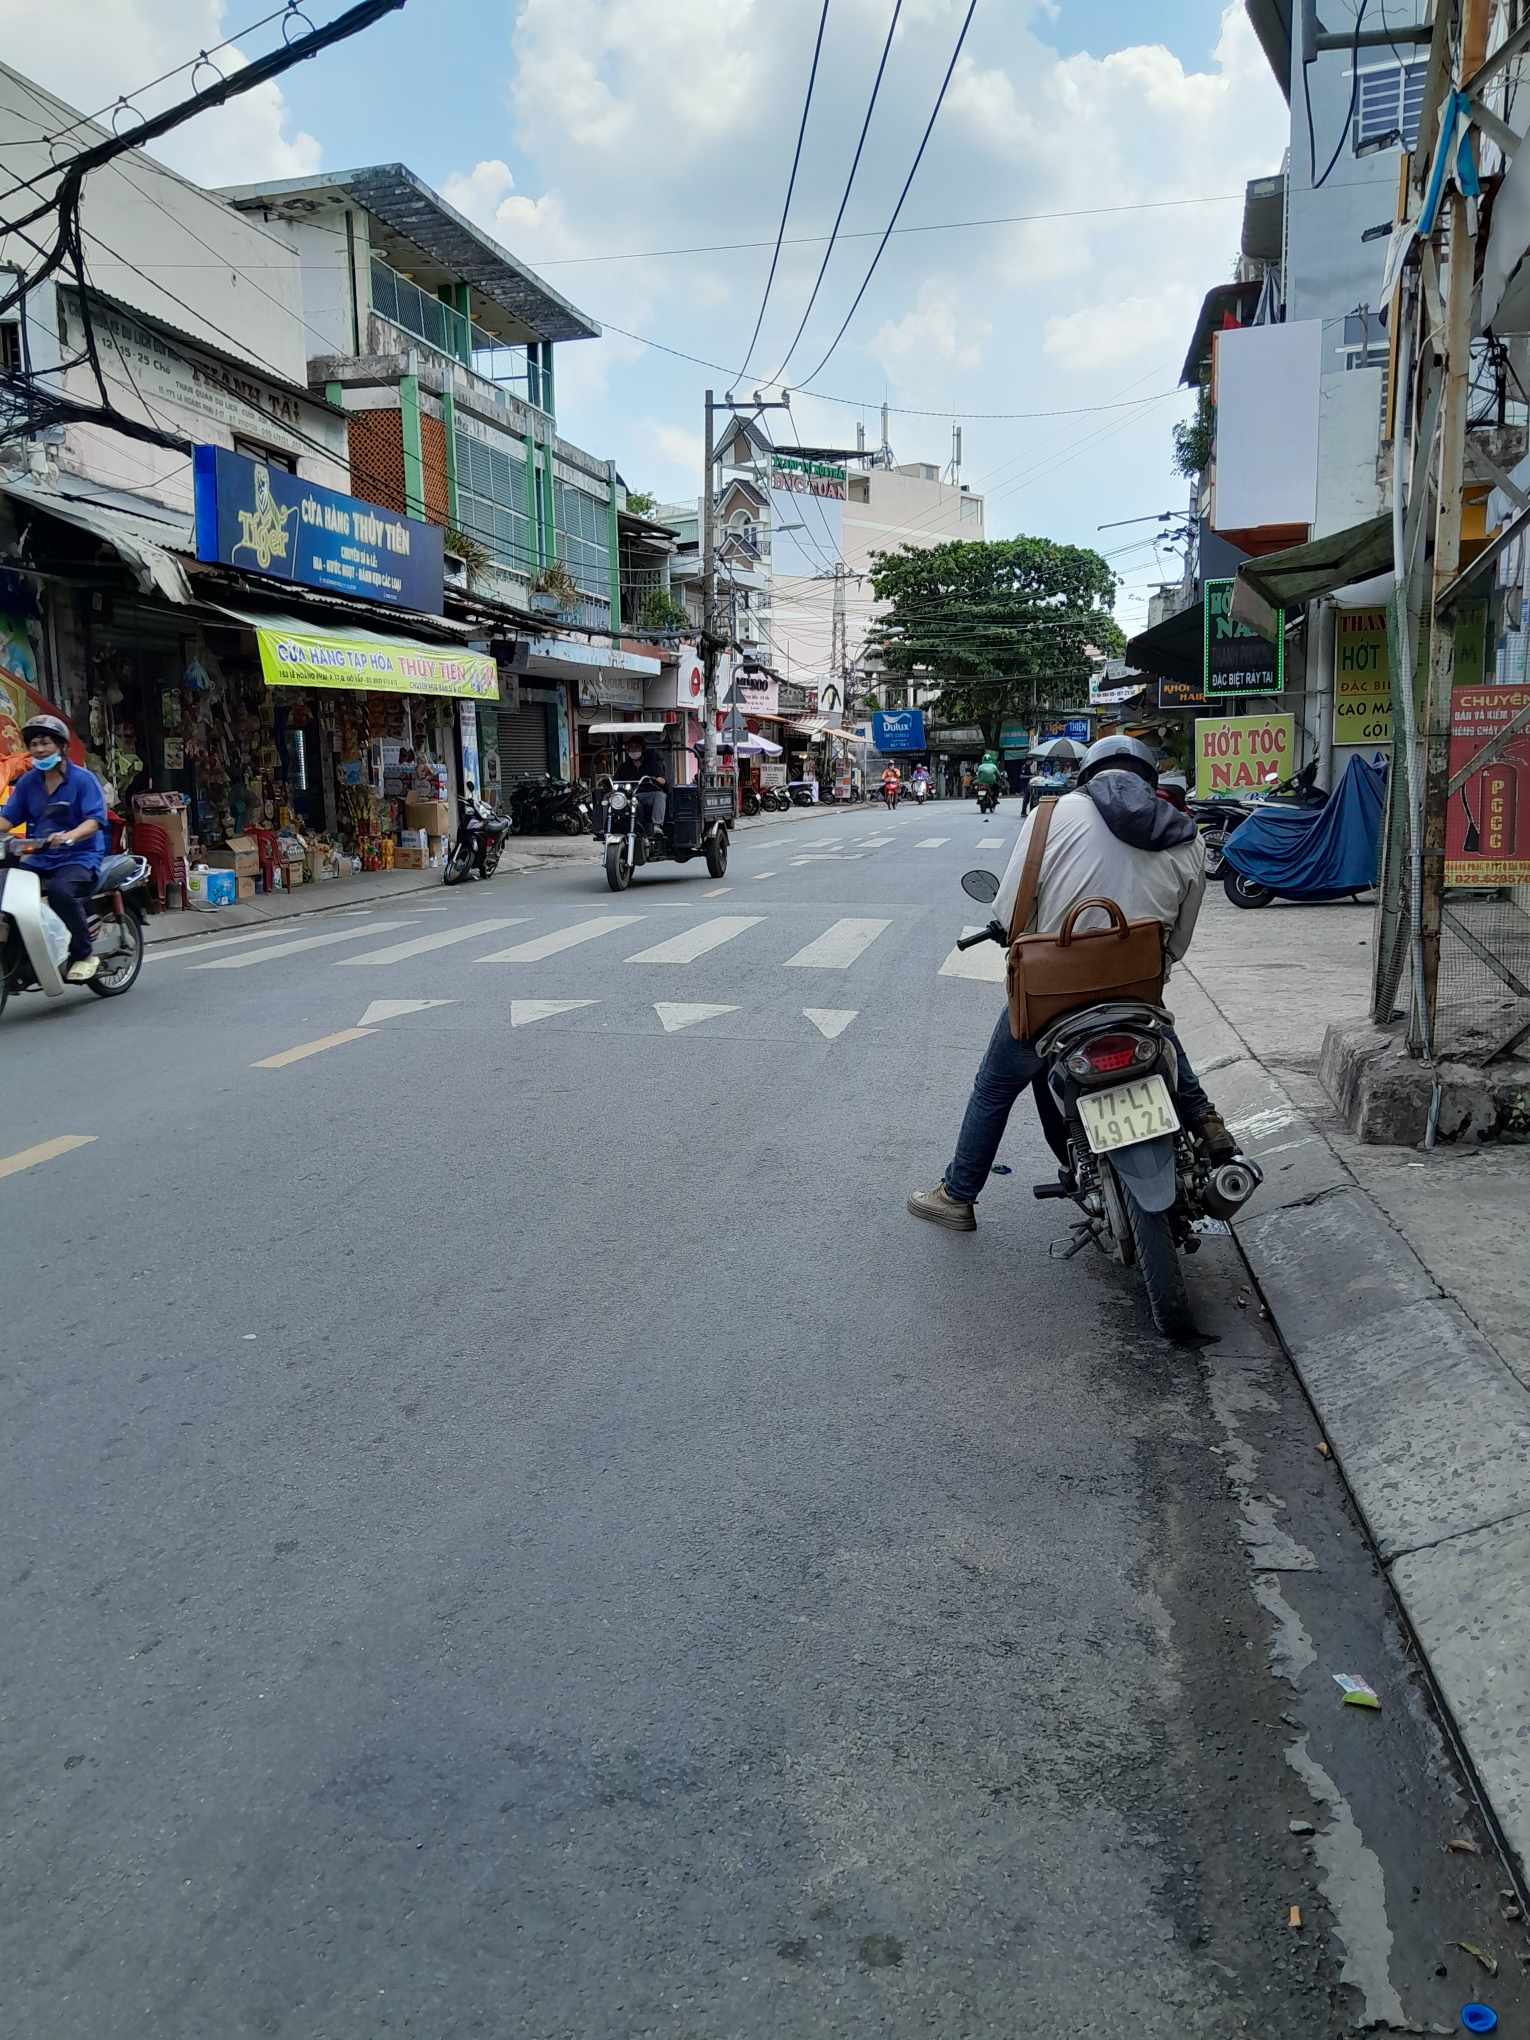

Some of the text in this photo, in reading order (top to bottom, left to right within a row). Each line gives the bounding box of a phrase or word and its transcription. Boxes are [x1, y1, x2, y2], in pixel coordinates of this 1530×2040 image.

[137, 352, 150, 366] 25
[238, 510, 289, 569] Tiger
[1342, 638, 1381, 671] HỚT
[1262, 672, 1274, 684] TAI
[883, 722, 909, 731] Dulux
[1203, 721, 1287, 757] HỚT TÓC
[1210, 759, 1280, 789] NAM
[1489, 780, 1505, 849] PCCC
[1094, 1107, 1172, 1146] 491.24
